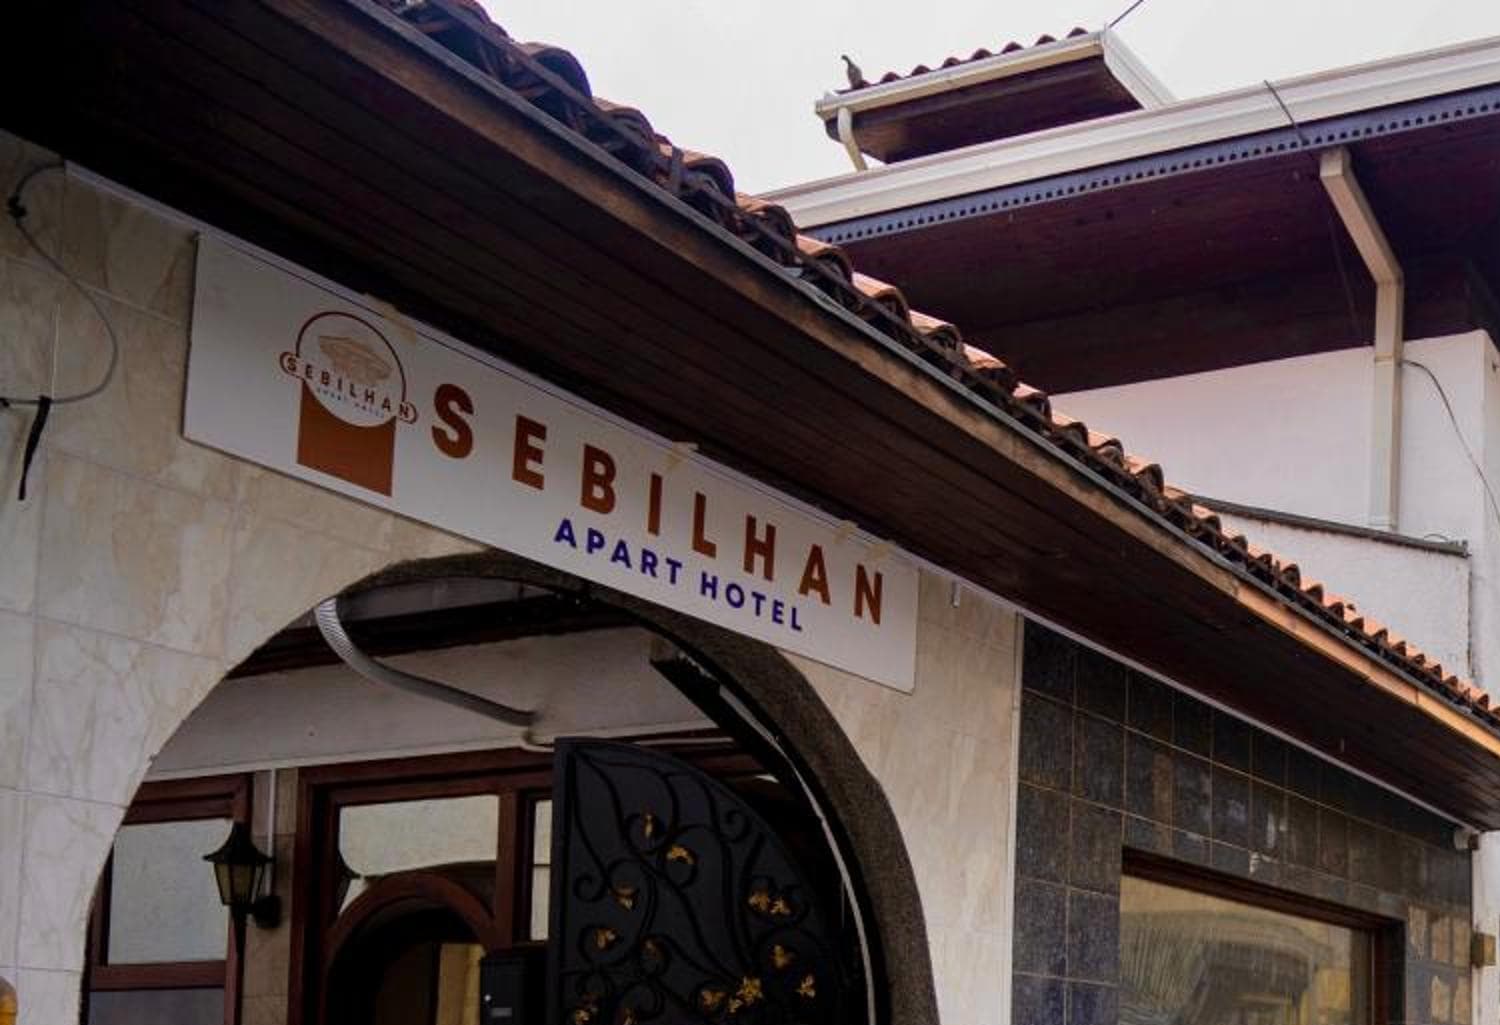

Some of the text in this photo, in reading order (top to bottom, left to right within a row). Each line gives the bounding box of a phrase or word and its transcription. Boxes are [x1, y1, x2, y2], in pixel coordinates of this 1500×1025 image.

[287, 356, 410, 418] SEBILHAN
[431, 383, 883, 625] SEBILHAN
[554, 518, 803, 632] APART HOTEL
